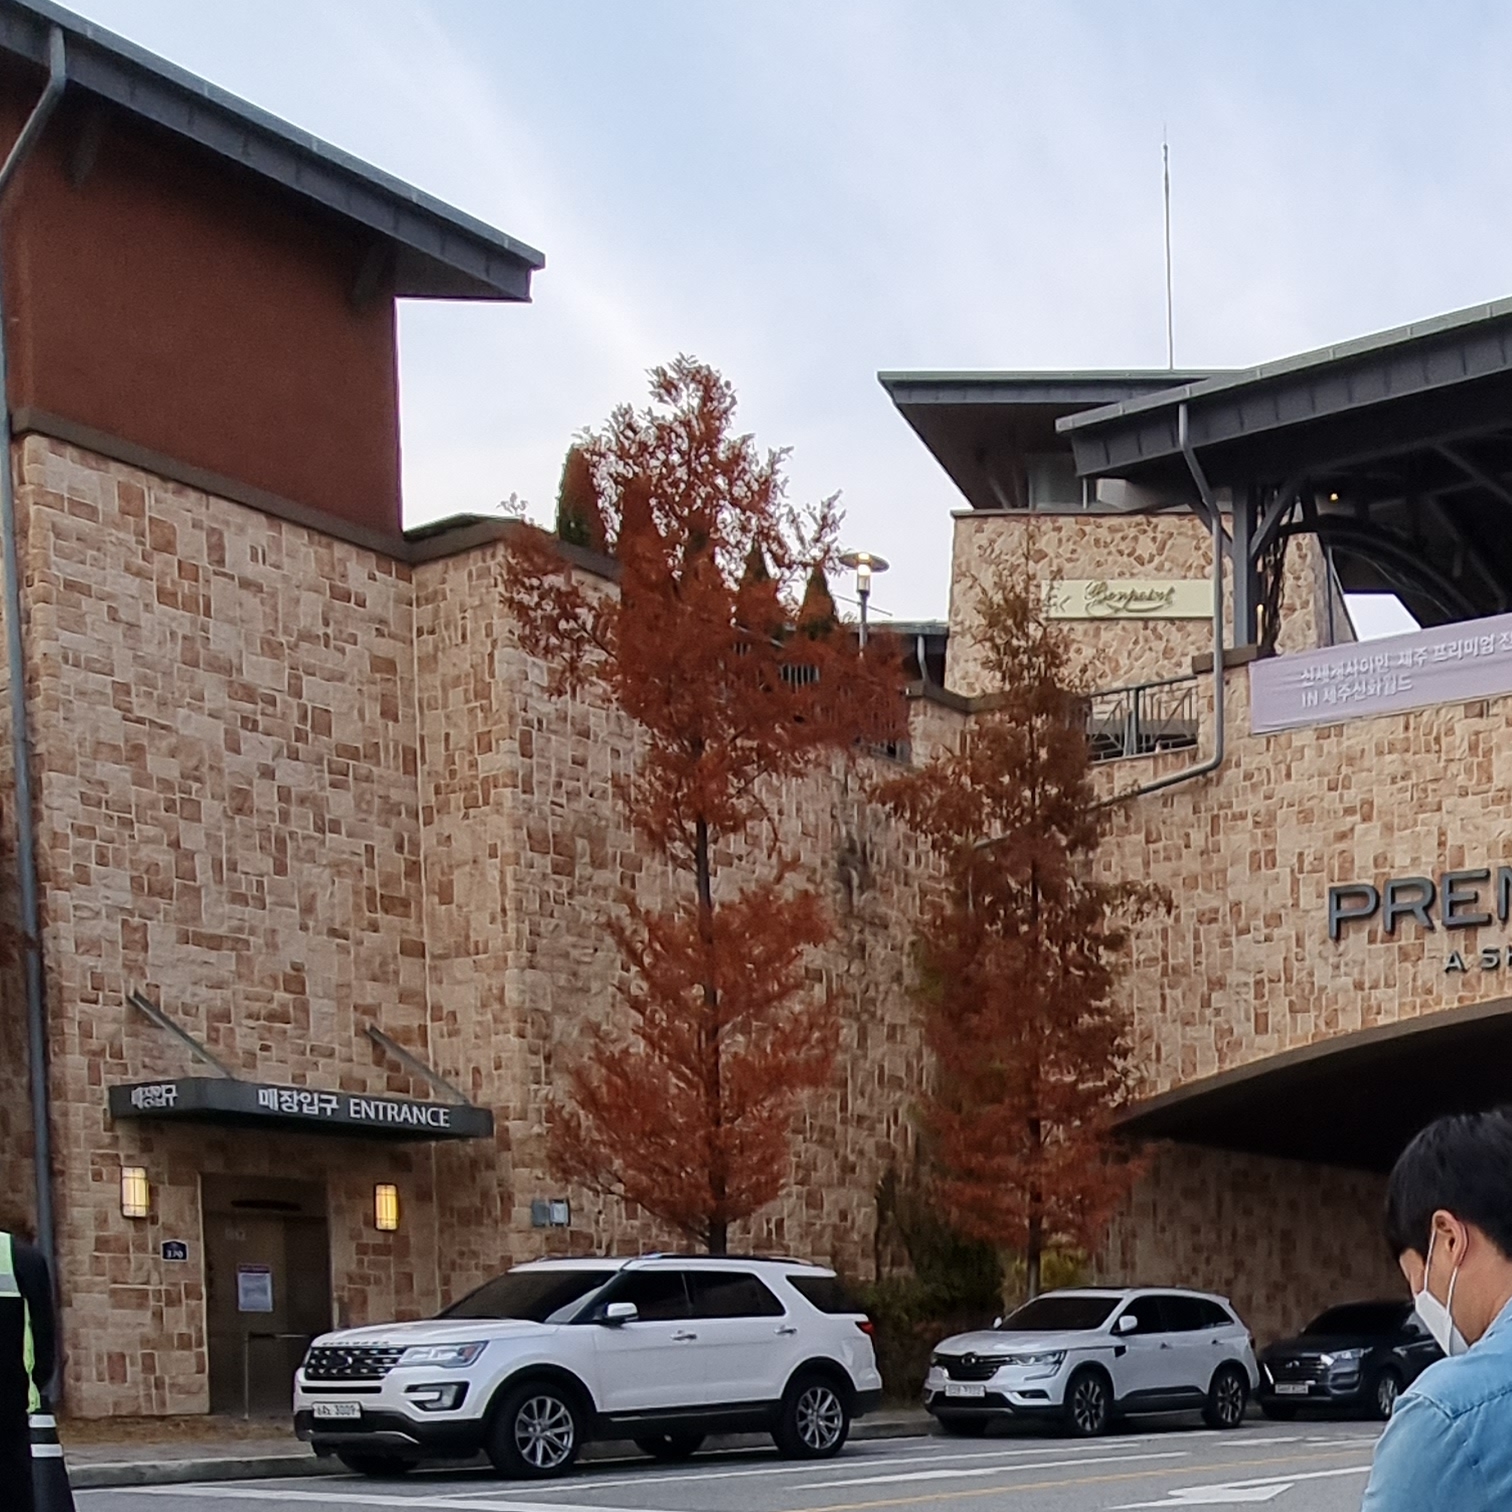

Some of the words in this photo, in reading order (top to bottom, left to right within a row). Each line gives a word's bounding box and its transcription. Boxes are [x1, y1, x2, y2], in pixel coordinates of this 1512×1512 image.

[1432, 633, 1496, 663] 프리미엄
[1301, 690, 1319, 708] IN
[1444, 949, 1468, 974] A
[258, 1087, 340, 1117] 매장입구
[349, 1098, 451, 1129] ENTRANCE
